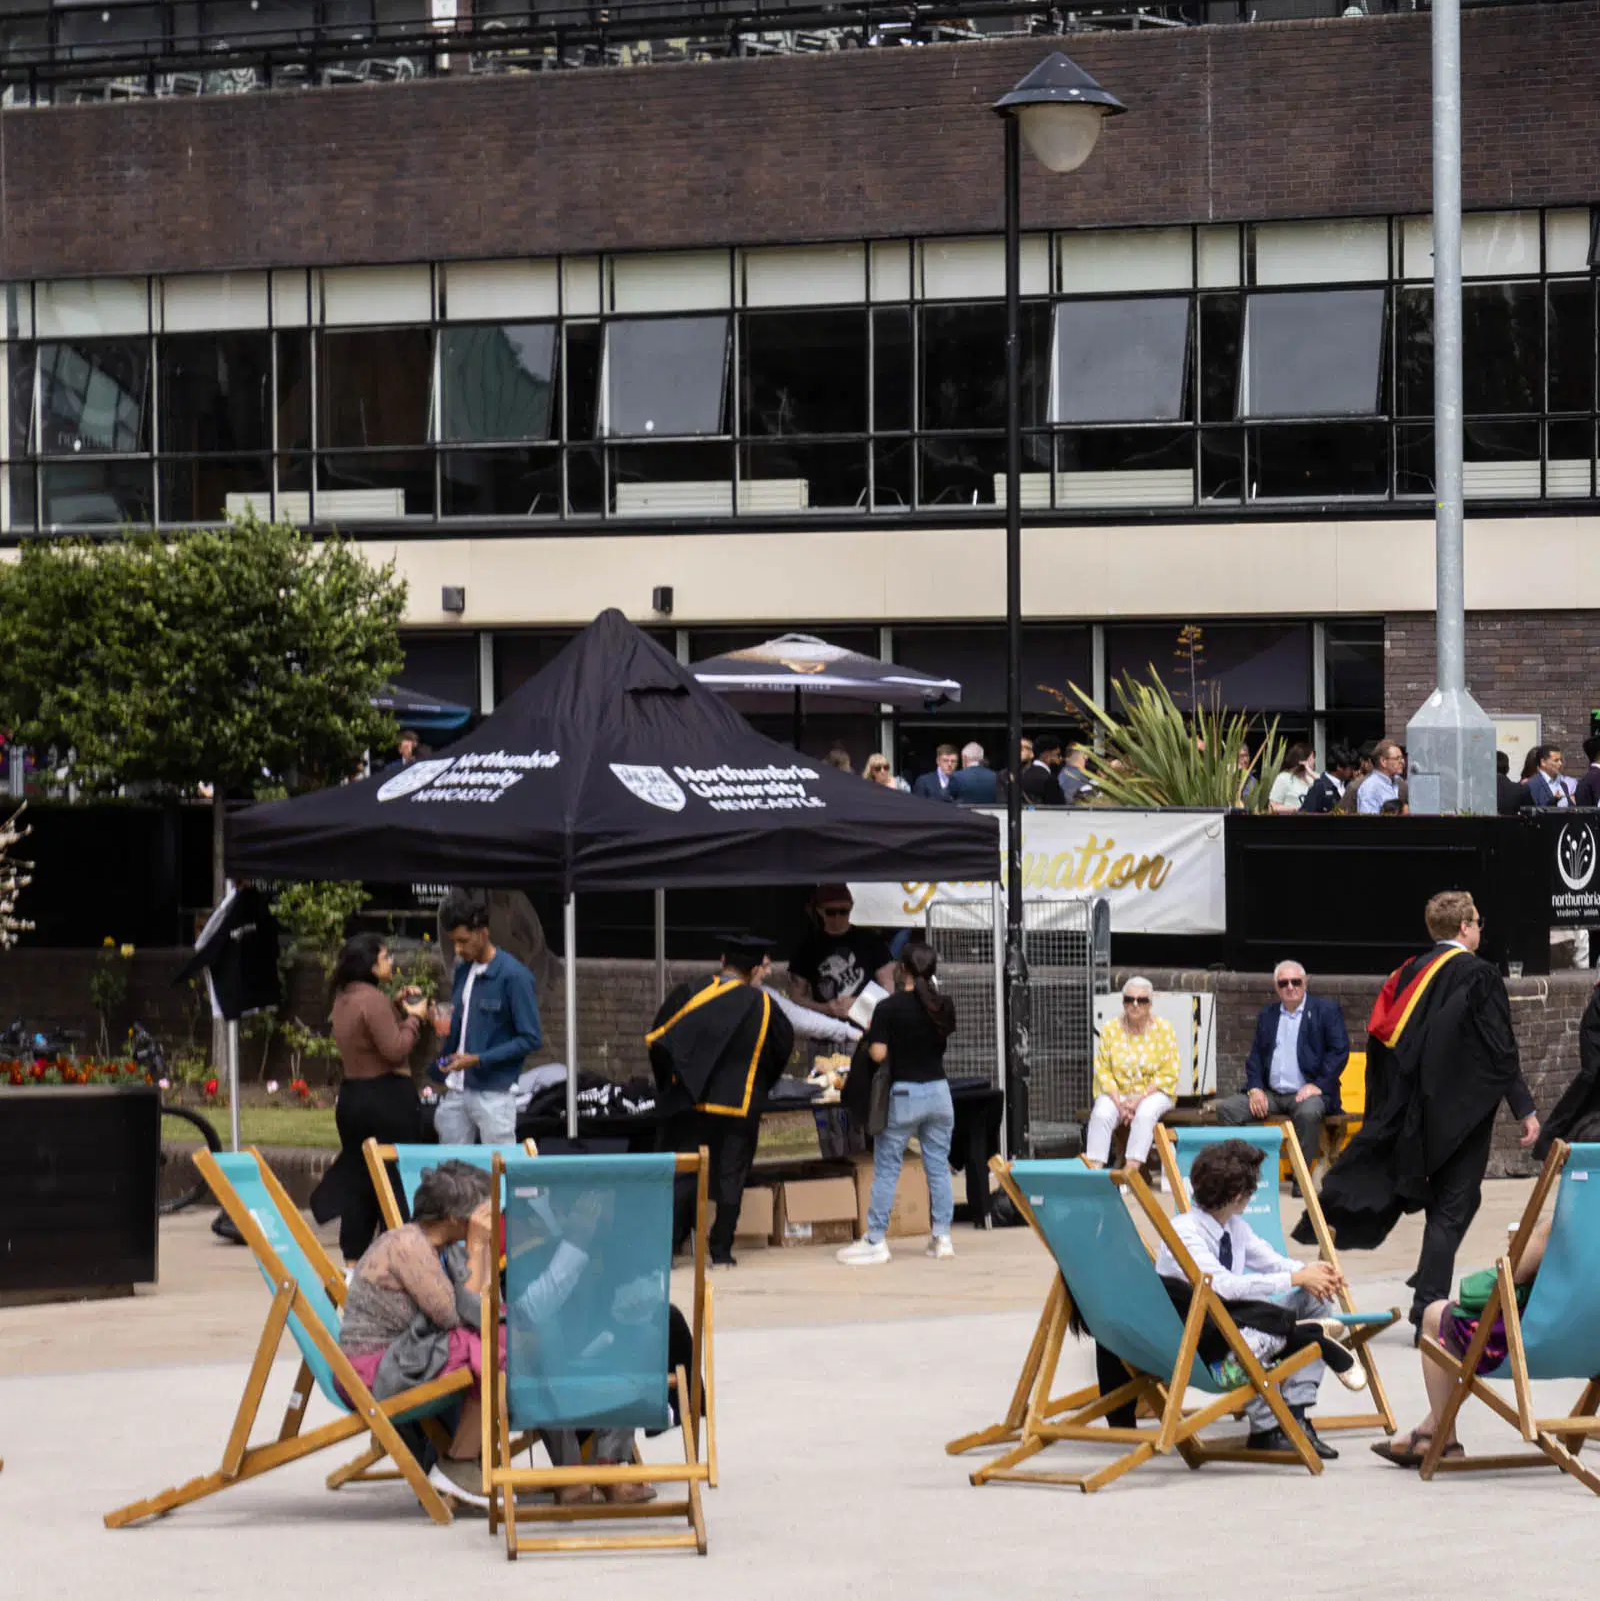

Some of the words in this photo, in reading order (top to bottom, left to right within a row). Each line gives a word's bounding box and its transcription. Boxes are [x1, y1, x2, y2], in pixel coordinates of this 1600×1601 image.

[450, 750, 560, 769] Northumbria
[433, 767, 523, 789] University
[673, 764, 819, 782] Northumbria
[688, 780, 806, 798] University
[709, 796, 827, 811] NEWCASTLE
